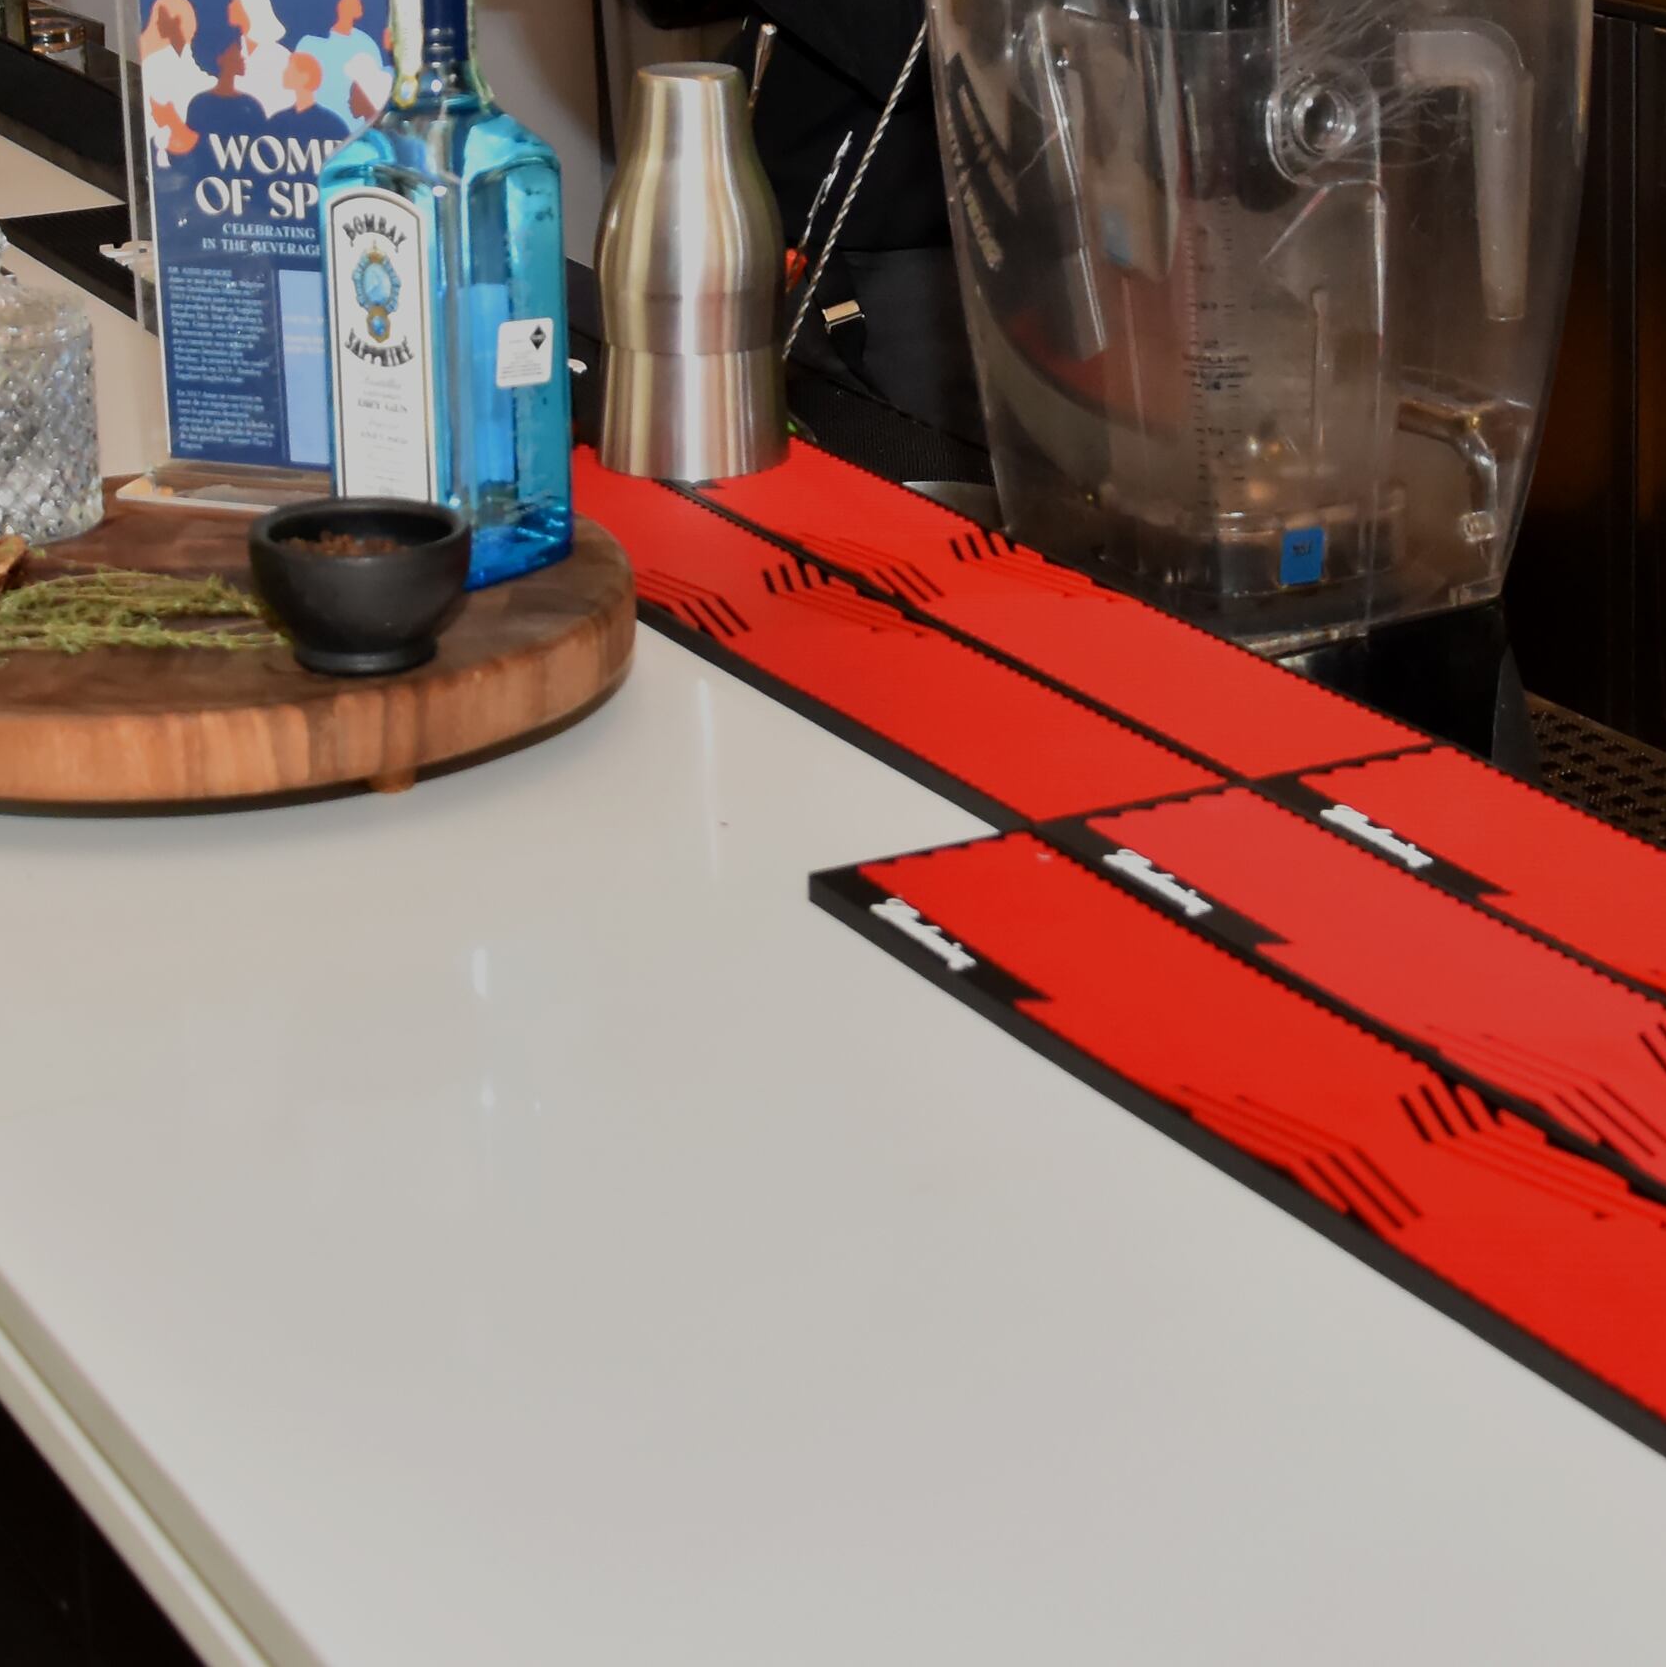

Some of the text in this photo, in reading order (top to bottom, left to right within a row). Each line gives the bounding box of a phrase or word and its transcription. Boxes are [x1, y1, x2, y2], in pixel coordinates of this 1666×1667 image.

[194, 176, 254, 217] OF
[202, 237, 217, 251] IN
[221, 238, 249, 253] THE
[222, 222, 316, 240] CELEBRATING
[341, 213, 408, 254] BOMBAY
[343, 327, 414, 368] SAPPHIRE
